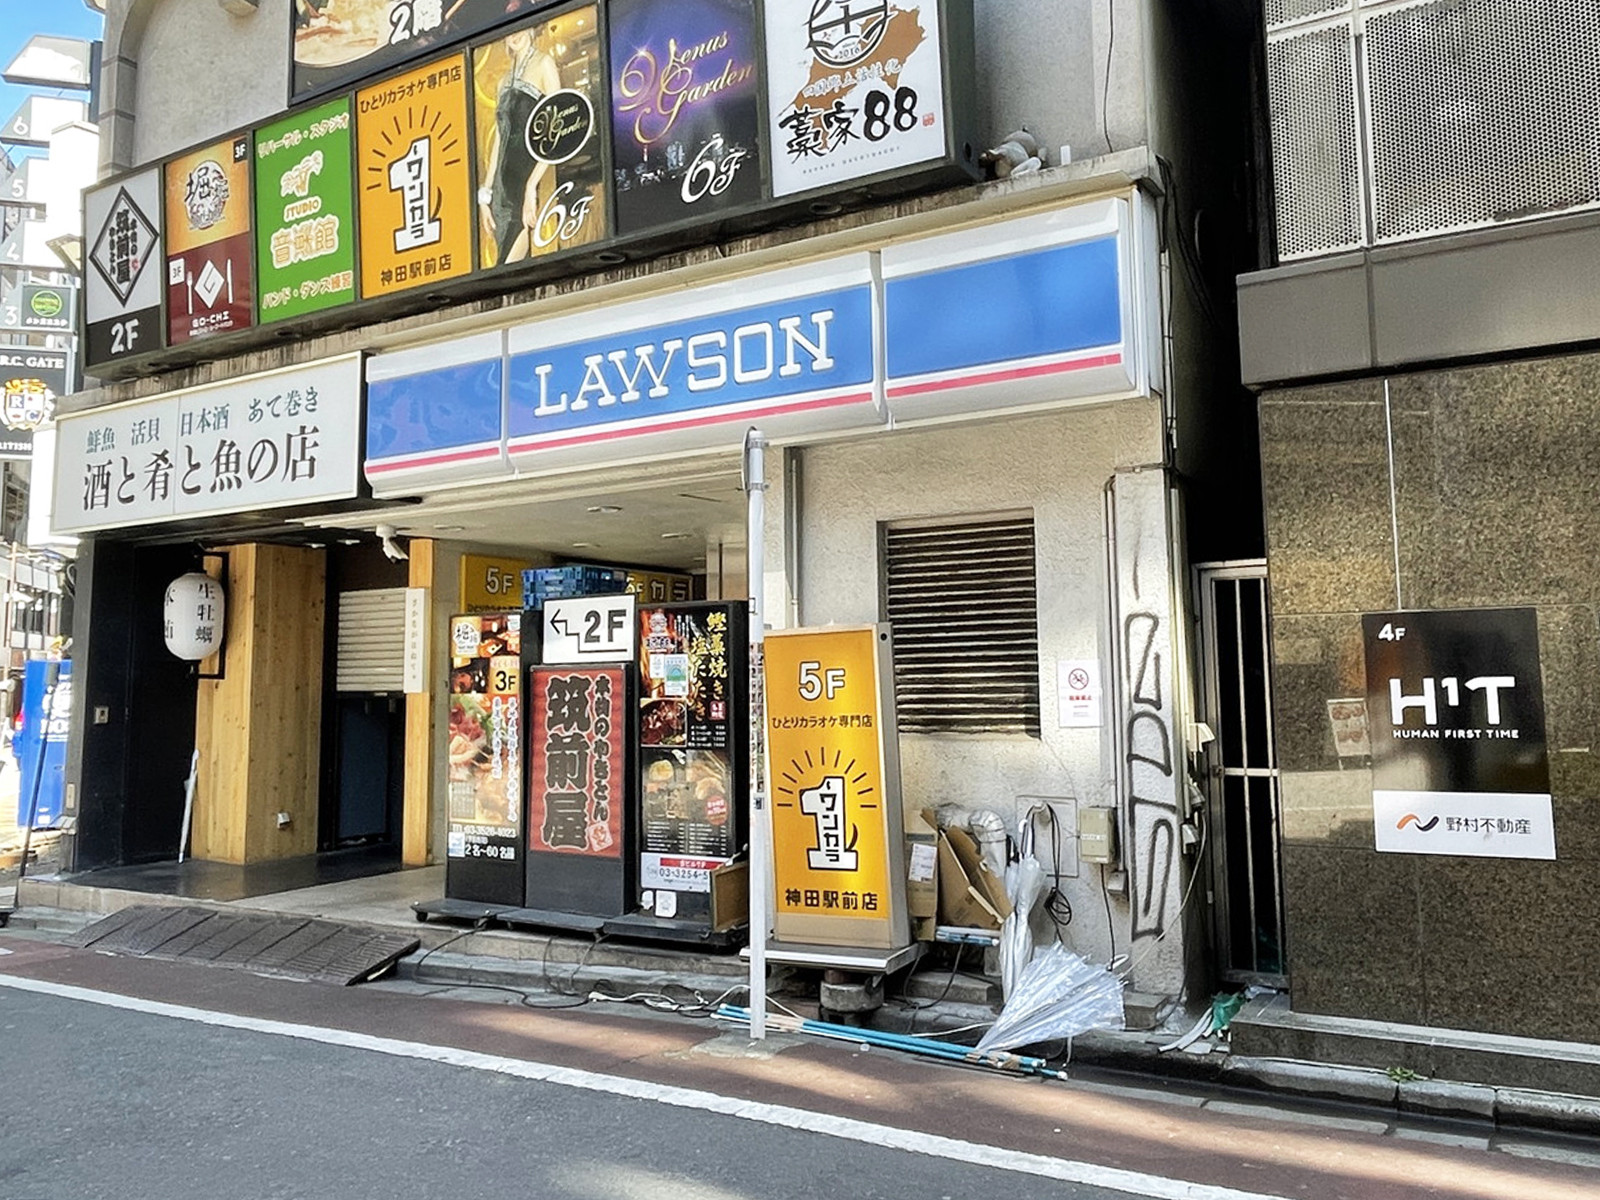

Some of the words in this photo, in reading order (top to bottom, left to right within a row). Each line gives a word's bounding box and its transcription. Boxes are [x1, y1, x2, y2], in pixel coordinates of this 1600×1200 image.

[360, 65, 462, 114] ひとりカラオケ専門店
[634, 59, 754, 144] Garden
[13, 116, 29, 135] 6
[234, 143, 246, 159] 3F
[681, 136, 746, 204] 6F
[11, 178, 25, 198] 5
[406, 157, 425, 240] ワンカラ
[533, 181, 594, 248] 6F
[6, 243, 20, 261] 4
[380, 253, 452, 287] 神田駅前店
[4, 305, 18, 326] 3
[111, 318, 139, 354] 2F
[26, 356, 65, 369] GATE
[533, 309, 835, 418] LAWSON
[86, 426, 116, 455] 鮮魚
[131, 417, 160, 446] 活貝
[180, 403, 230, 437] 日本酒
[248, 386, 319, 424] あて巻き
[82, 425, 320, 511] 酒と肴と魚の店
[485, 566, 514, 595] 5F
[584, 608, 627, 644] 2F
[1378, 623, 1406, 642] 4F
[495, 670, 516, 692] 3F
[798, 660, 846, 701] 5F
[772, 715, 873, 729] ひとりカラオケ専門店
[1393, 729, 1440, 739] HUMAN
[1445, 729, 1481, 739] FIRST
[1486, 729, 1519, 739] TIME
[819, 792, 840, 862] ワンカラ
[1445, 816, 1532, 835] 野村不動産
[659, 867, 709, 880] 03-3254-5
[785, 888, 878, 911] 神田駅前店
